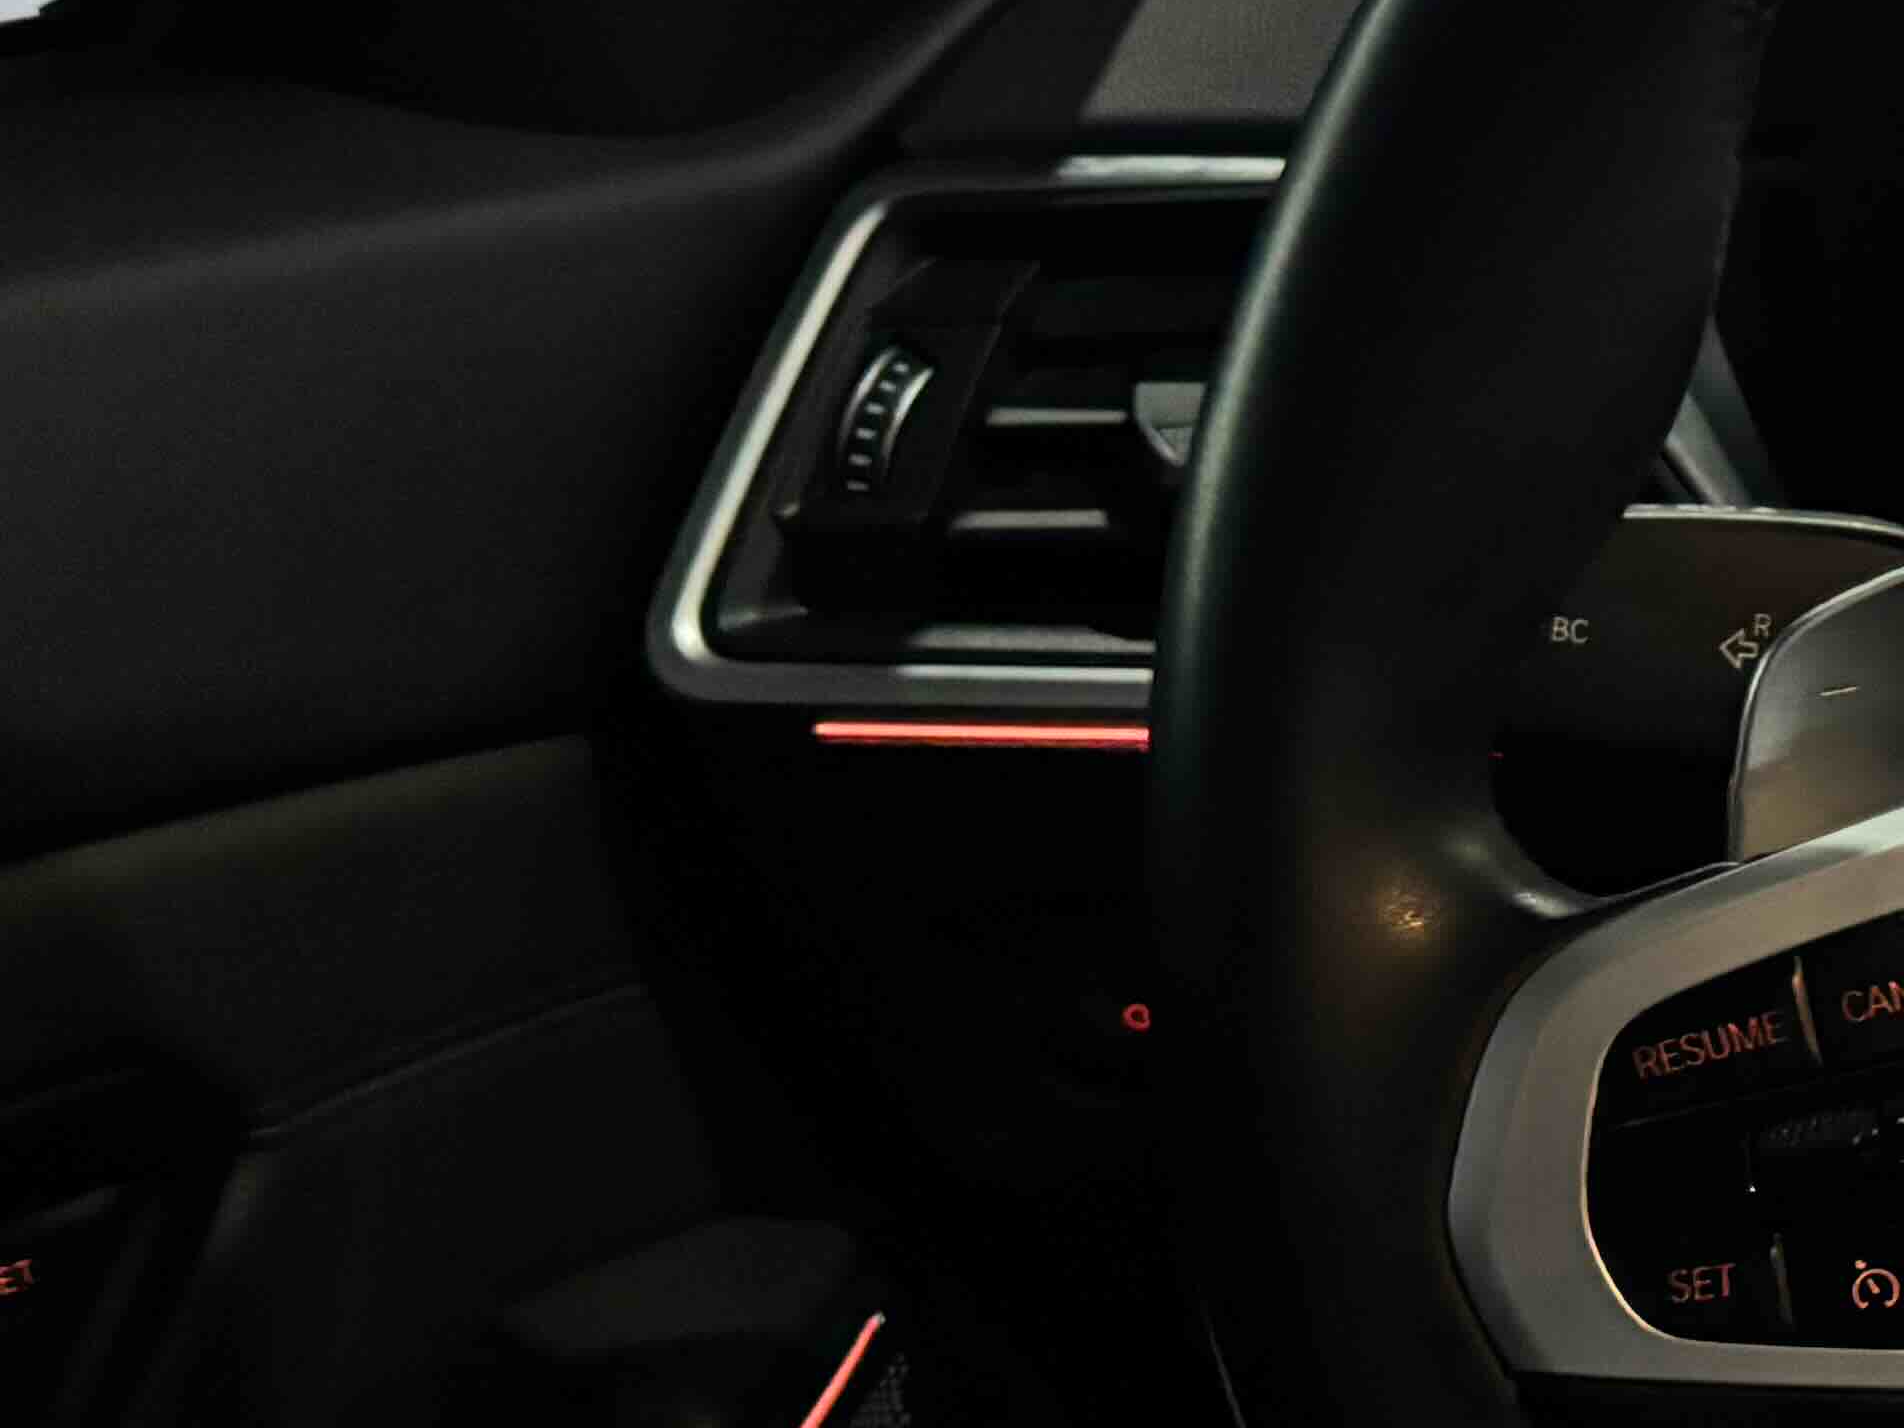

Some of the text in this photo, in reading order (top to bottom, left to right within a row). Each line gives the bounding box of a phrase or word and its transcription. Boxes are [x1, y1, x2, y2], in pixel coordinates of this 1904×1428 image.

[1549, 615, 1591, 645] BC
[1631, 1010, 1788, 1080] RESUME
[1669, 1262, 1736, 1304] SET
